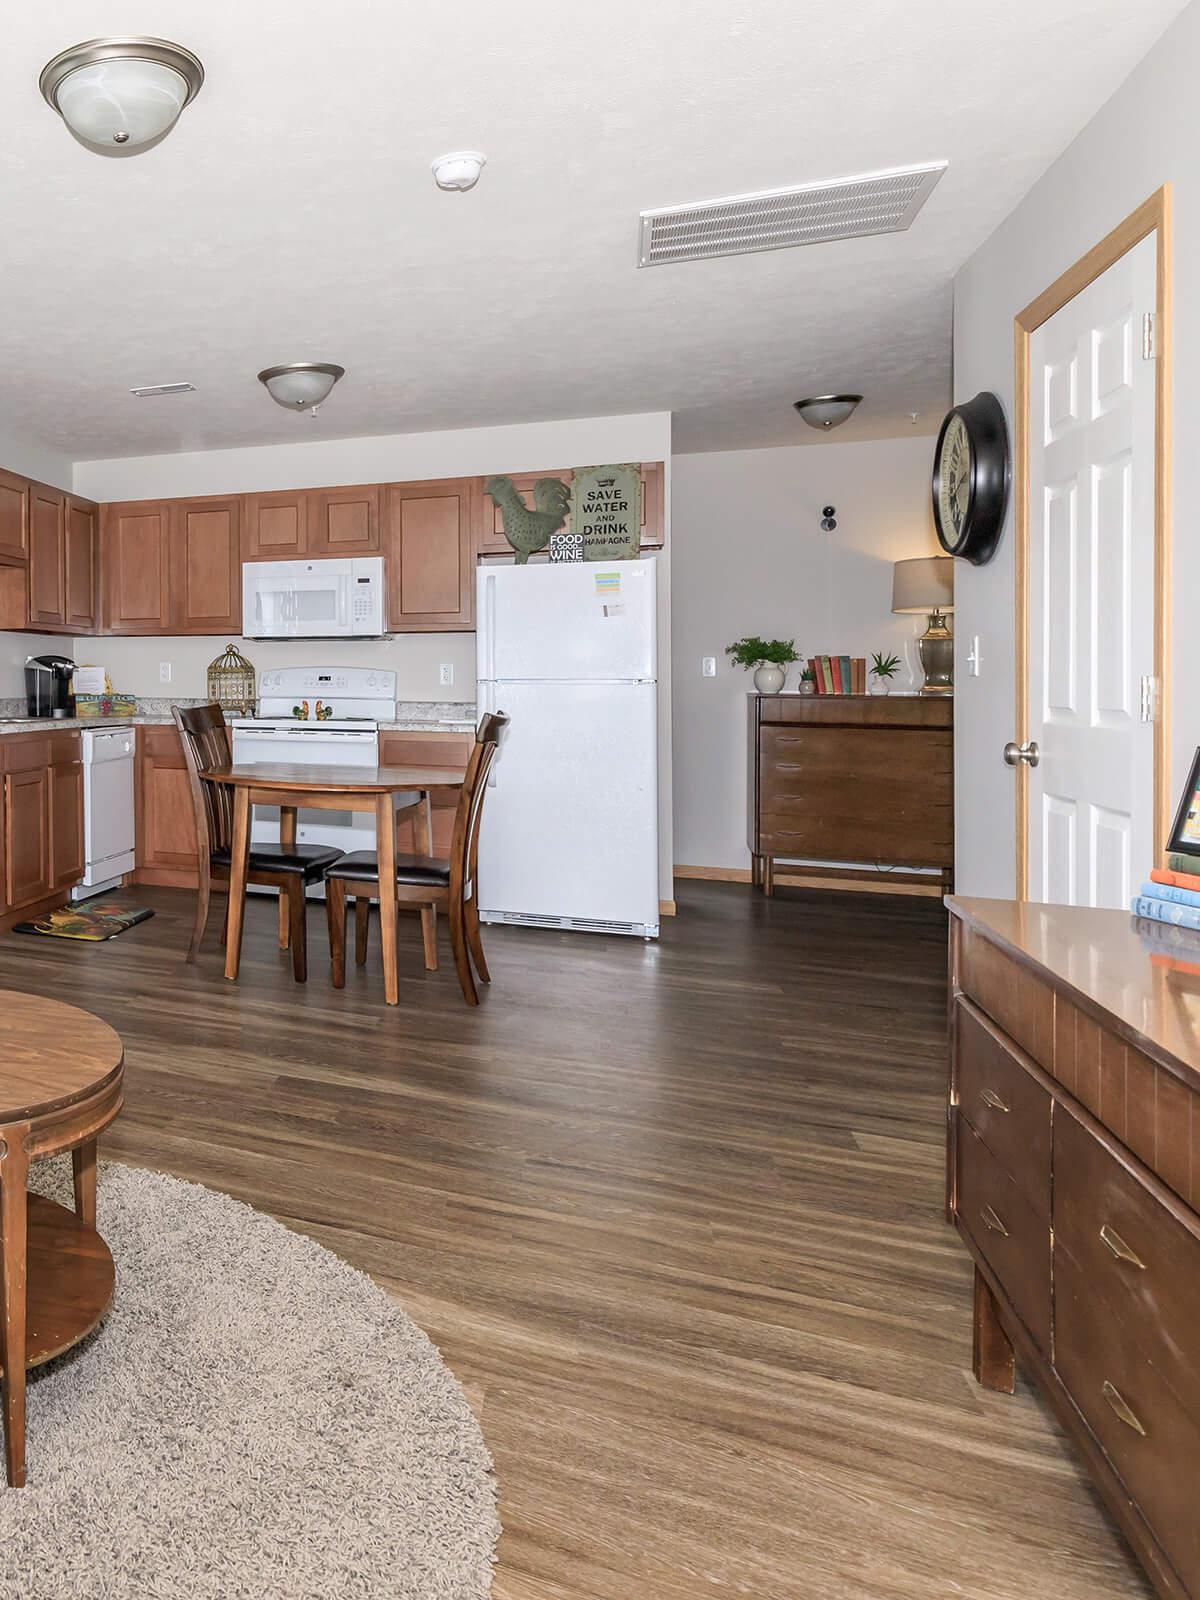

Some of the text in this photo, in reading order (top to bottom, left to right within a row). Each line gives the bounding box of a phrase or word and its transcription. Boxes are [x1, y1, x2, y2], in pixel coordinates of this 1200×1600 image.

[587, 490, 622, 501] SAVE
[582, 501, 628, 513] WATER
[583, 523, 628, 535] DRINK
[550, 534, 583, 544] FOOD
[584, 536, 630, 545] HAMPAGNE
[550, 549, 583, 560] WINE
